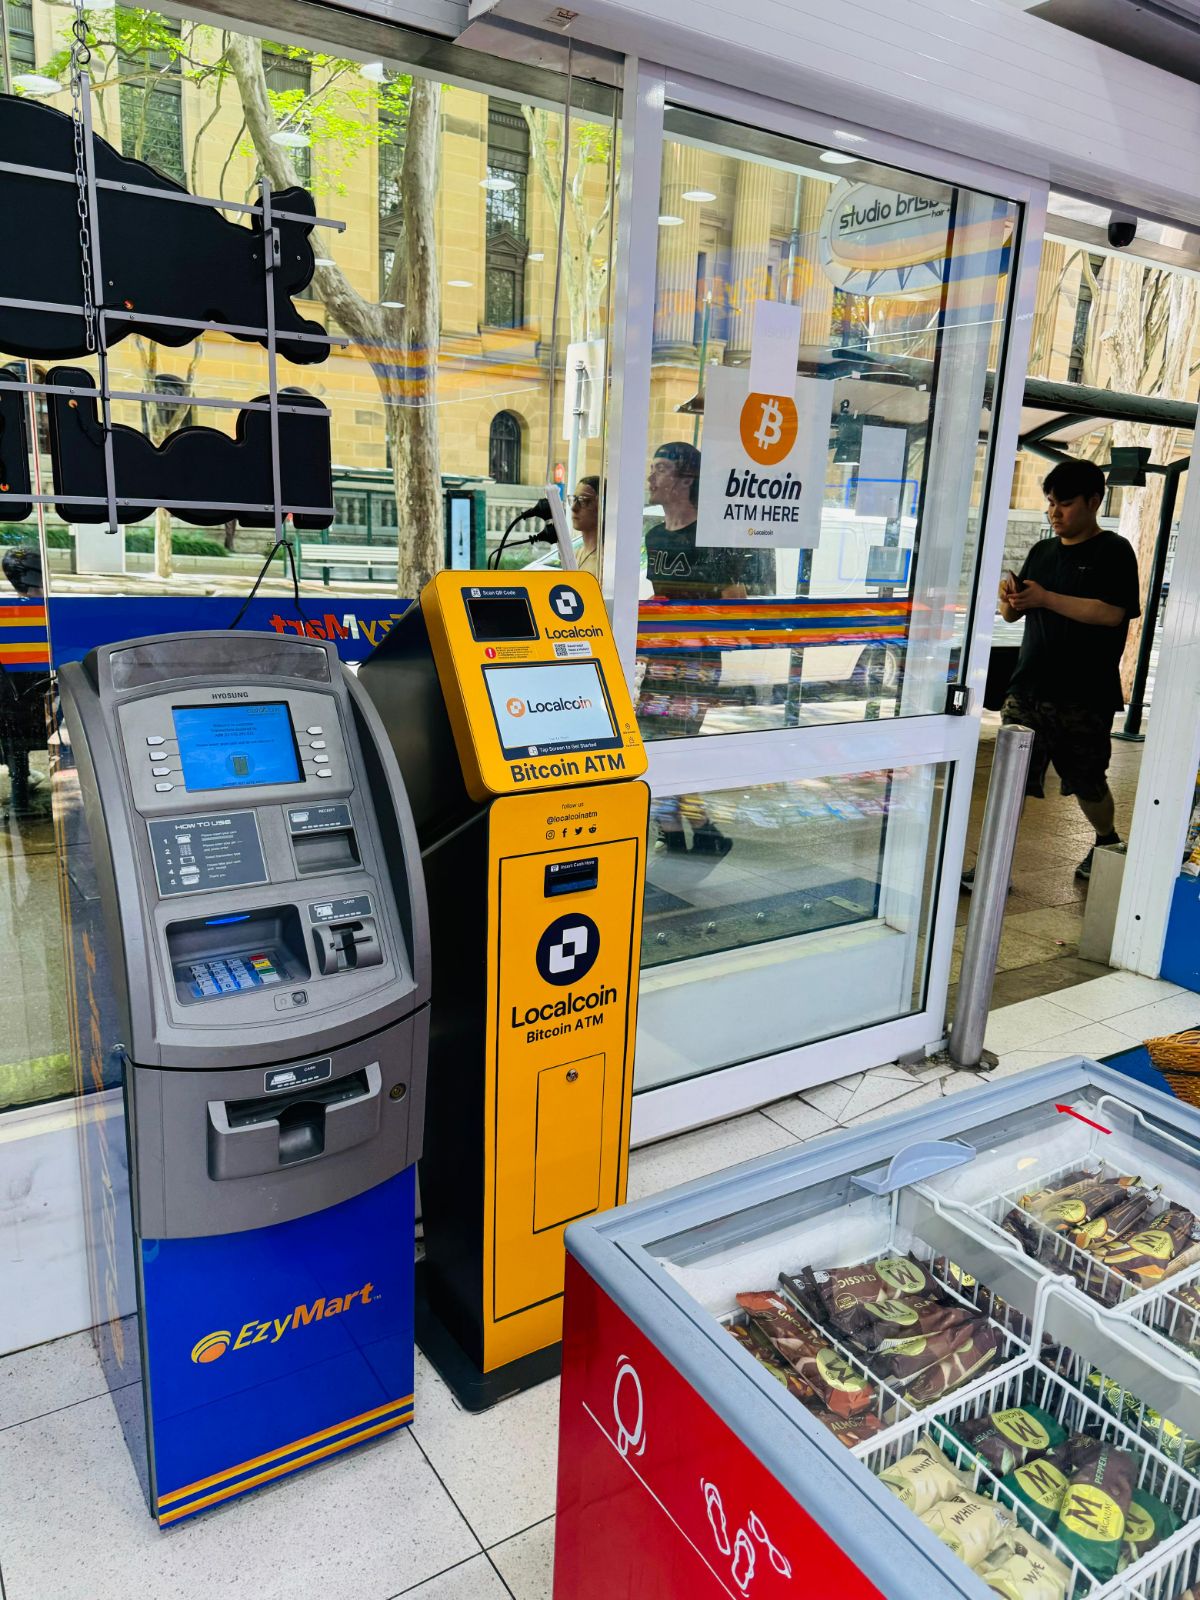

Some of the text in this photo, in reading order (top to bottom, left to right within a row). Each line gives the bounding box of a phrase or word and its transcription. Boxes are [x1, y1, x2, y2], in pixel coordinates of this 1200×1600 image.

[839, 199, 891, 230] studio
[725, 468, 802, 501] bitcoin
[723, 503, 800, 523] ATM HERE
[545, 624, 604, 640] Localcoin
[211, 691, 249, 700] HYOSUNG
[526, 695, 593, 714] Localcoin
[549, 744, 565, 752] Screen
[580, 741, 597, 749] Started
[510, 753, 626, 783] Bitcoin ATM
[175, 822, 196, 830] HOW
[546, 810, 598, 825] @localcoinatm
[511, 984, 618, 1029] Localcoin
[526, 1012, 605, 1044] Bitcoin ATM
[836, 1273, 878, 1289] CLASSIC
[232, 1281, 375, 1352] EzyMart
[1003, 1416, 1045, 1442] M
[908, 1456, 939, 1475] WHITE
[1094, 1453, 1108, 1485] PEPPER
[1020, 1463, 1061, 1496] M
[950, 1503, 982, 1526] WHITE
[1066, 1494, 1103, 1531] M
[1099, 1502, 1113, 1537] MAGNUM
